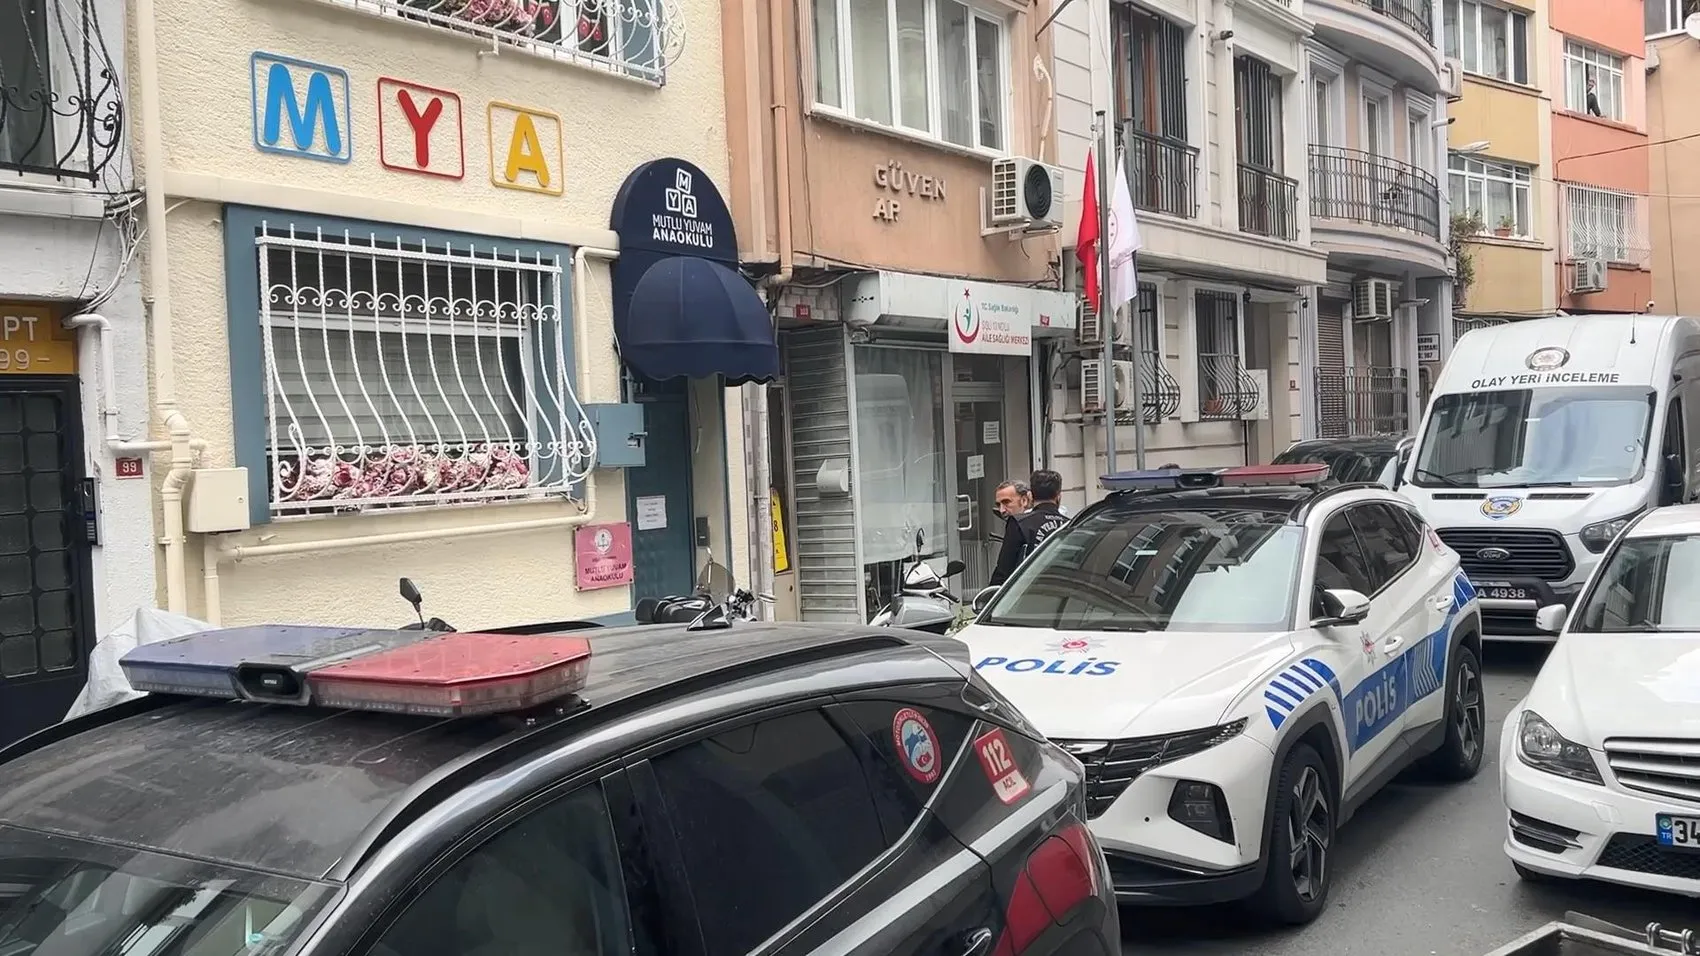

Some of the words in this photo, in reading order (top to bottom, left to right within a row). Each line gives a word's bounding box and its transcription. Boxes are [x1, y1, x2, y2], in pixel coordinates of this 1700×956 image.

[264, 62, 342, 156] M
[397, 88, 443, 168] Y
[505, 111, 551, 188] A
[874, 160, 946, 200] GÜVEN
[652, 214, 682, 231] MUTLU
[683, 218, 713, 235] YUVAM
[653, 227, 713, 248] ANAOKULU
[0, 316, 38, 341] PT
[1471, 376, 1507, 389] OLAY
[1510, 374, 1542, 385] YERİ
[1545, 373, 1620, 383] İNCELEME
[122, 461, 137, 473] 99
[1490, 588, 1526, 598] 4938
[975, 656, 1121, 676] POLİS
[1355, 670, 1397, 736] POLİS
[982, 739, 1012, 776] 112
[1661, 831, 1672, 840] TR
